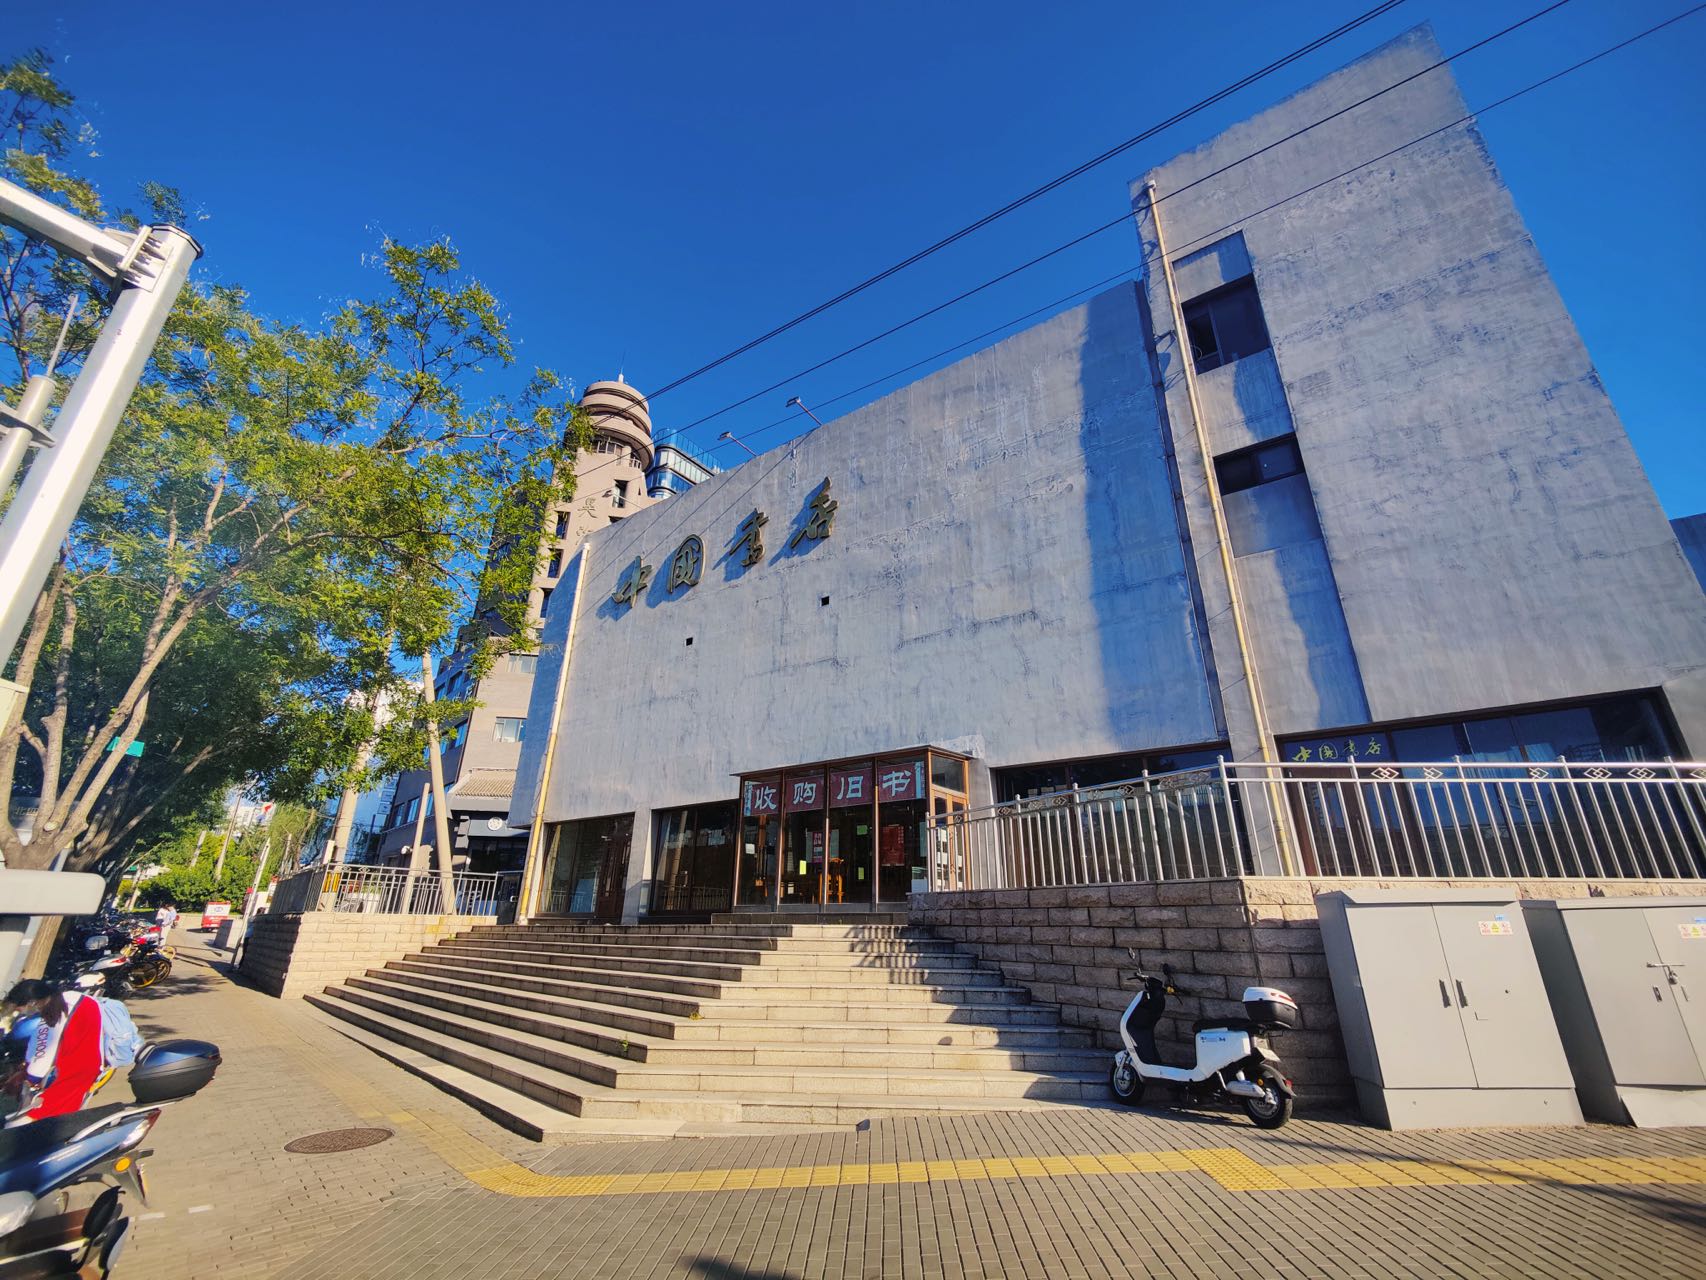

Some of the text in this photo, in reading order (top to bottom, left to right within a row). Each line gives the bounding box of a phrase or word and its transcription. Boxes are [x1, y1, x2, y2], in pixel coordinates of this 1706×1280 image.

[754, 770, 912, 811] 收购旧书
[33, 1027, 49, 1063] SCHOOL
